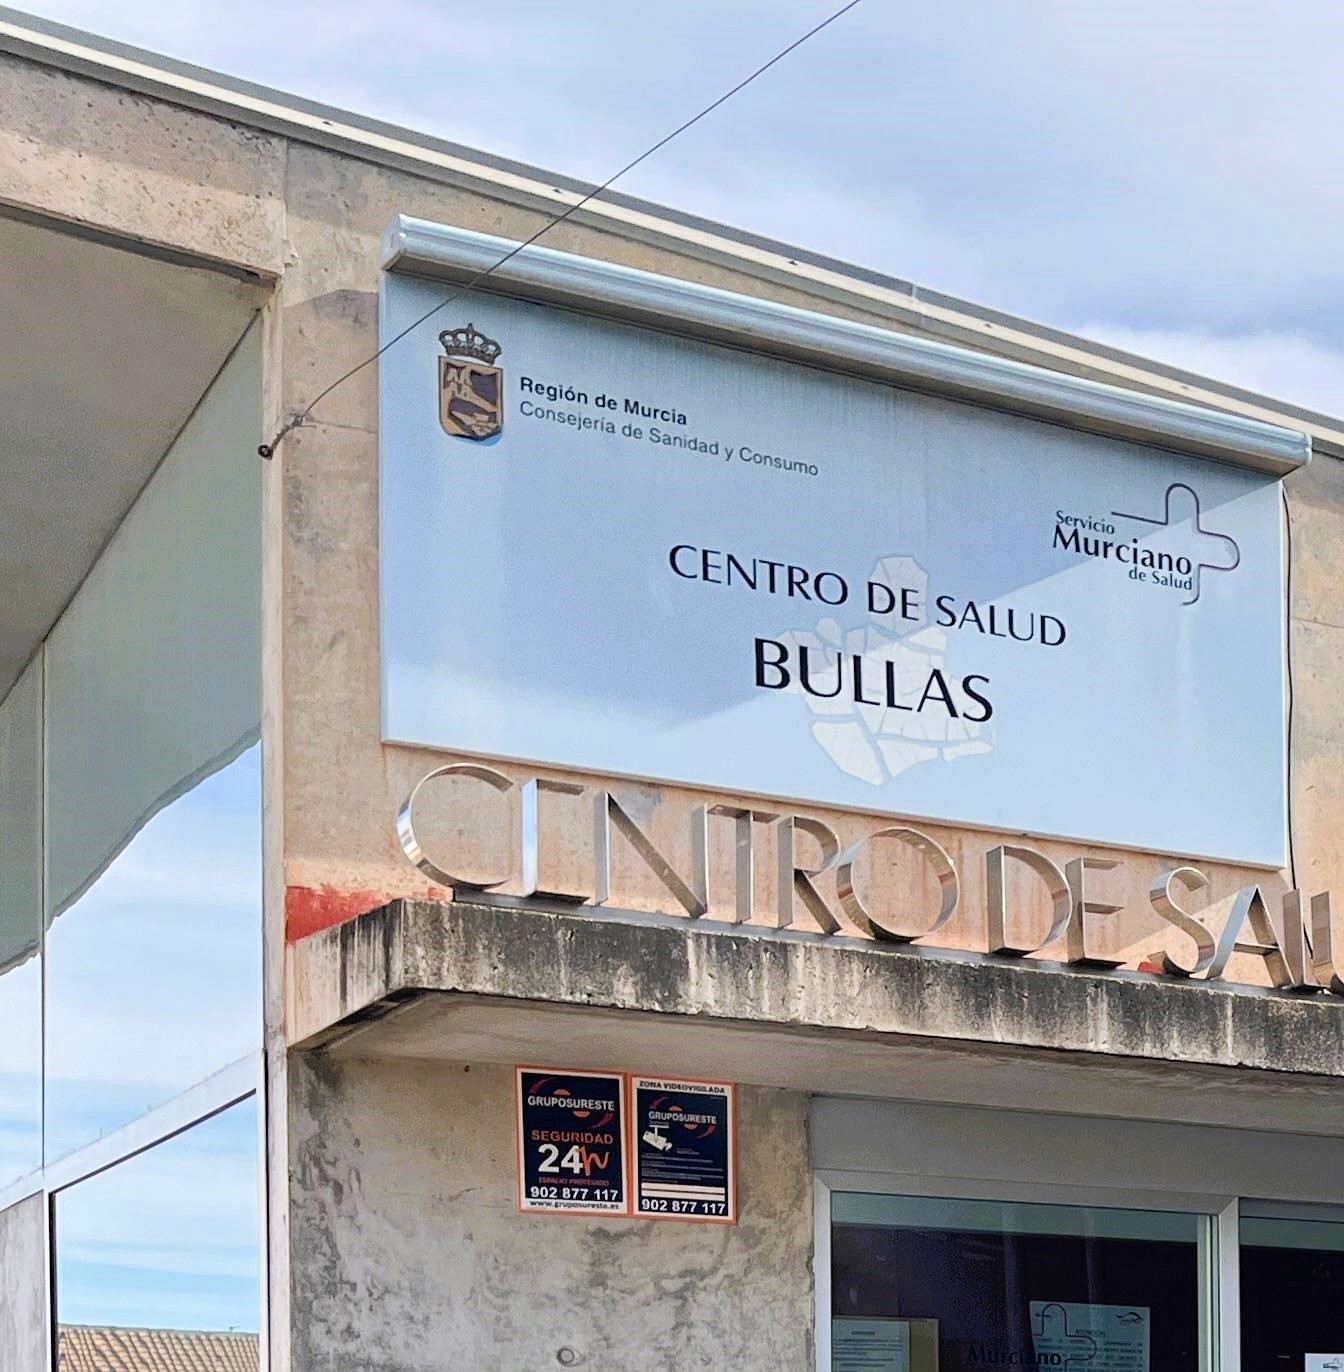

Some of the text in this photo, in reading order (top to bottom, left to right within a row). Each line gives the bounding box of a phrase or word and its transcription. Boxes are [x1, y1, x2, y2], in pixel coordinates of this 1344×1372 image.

[520, 376, 688, 426] Región de Murcia
[519, 401, 819, 477] Consejería de Sanidad y Consumo
[1055, 509, 1115, 535] Servicio
[1052, 524, 1192, 576] Murciano
[1128, 566, 1193, 592] de Salud
[669, 544, 1067, 646] CENTRO DE SALUD
[755, 637, 993, 723] BULLAS
[397, 762, 960, 942] CENTRO
[987, 844, 1126, 968] DE
[527, 1095, 615, 1111] GRUPOSURESTE
[648, 1111, 717, 1124] GRUPOSURESTE
[531, 1129, 614, 1144] SEGURIDAD
[530, 1186, 618, 1200] 902 877 117
[641, 1199, 726, 1214] 902 877 117
